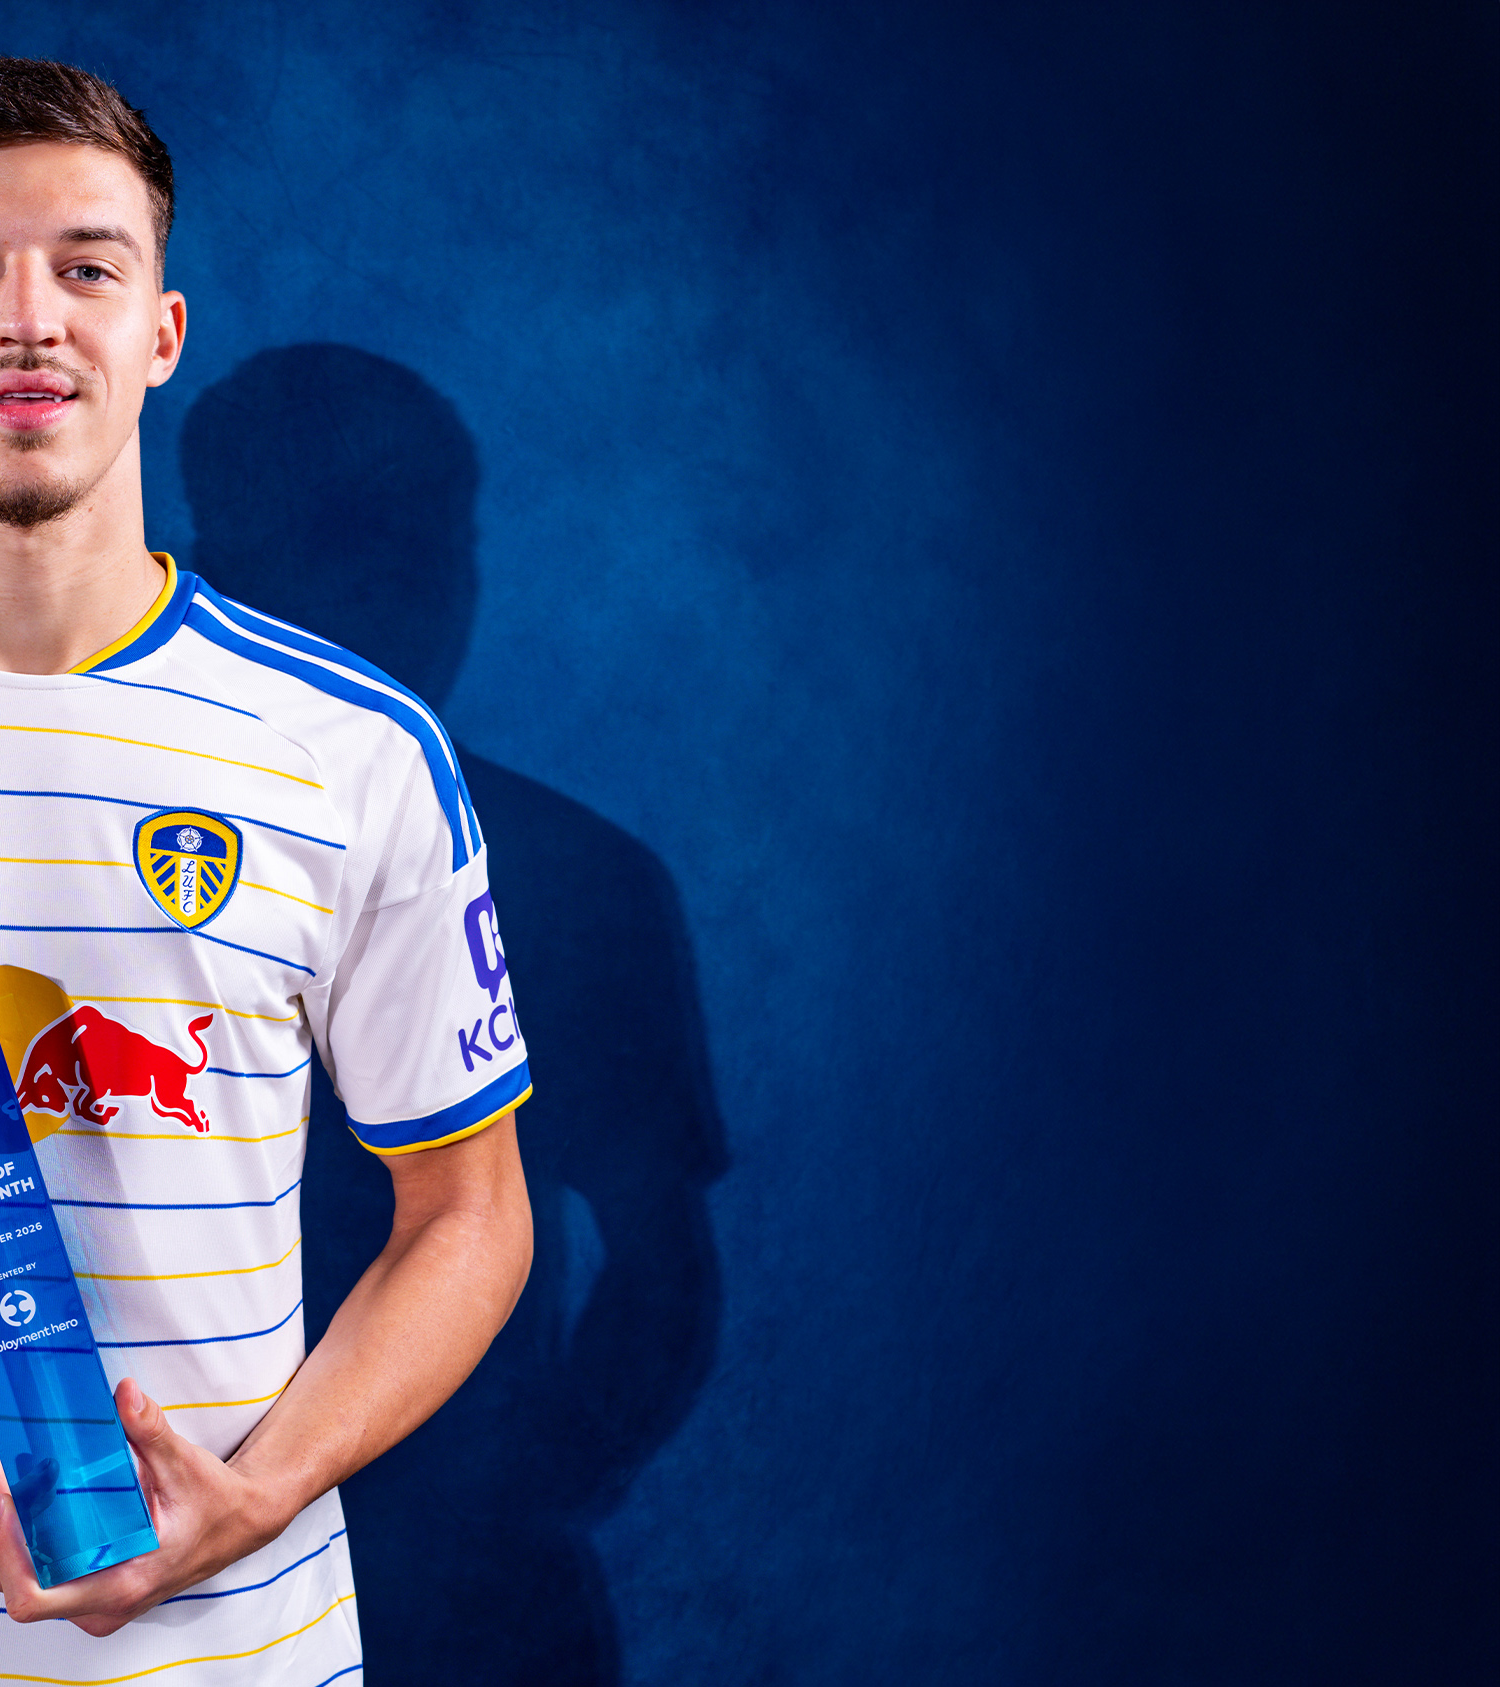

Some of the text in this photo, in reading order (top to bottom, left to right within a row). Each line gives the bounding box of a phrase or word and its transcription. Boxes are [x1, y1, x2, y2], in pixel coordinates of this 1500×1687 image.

[181, 860, 196, 913] LUFC
[15, 1222, 43, 1238] 2026
[25, 1262, 37, 1271] BY
[50, 1318, 79, 1334] hero
